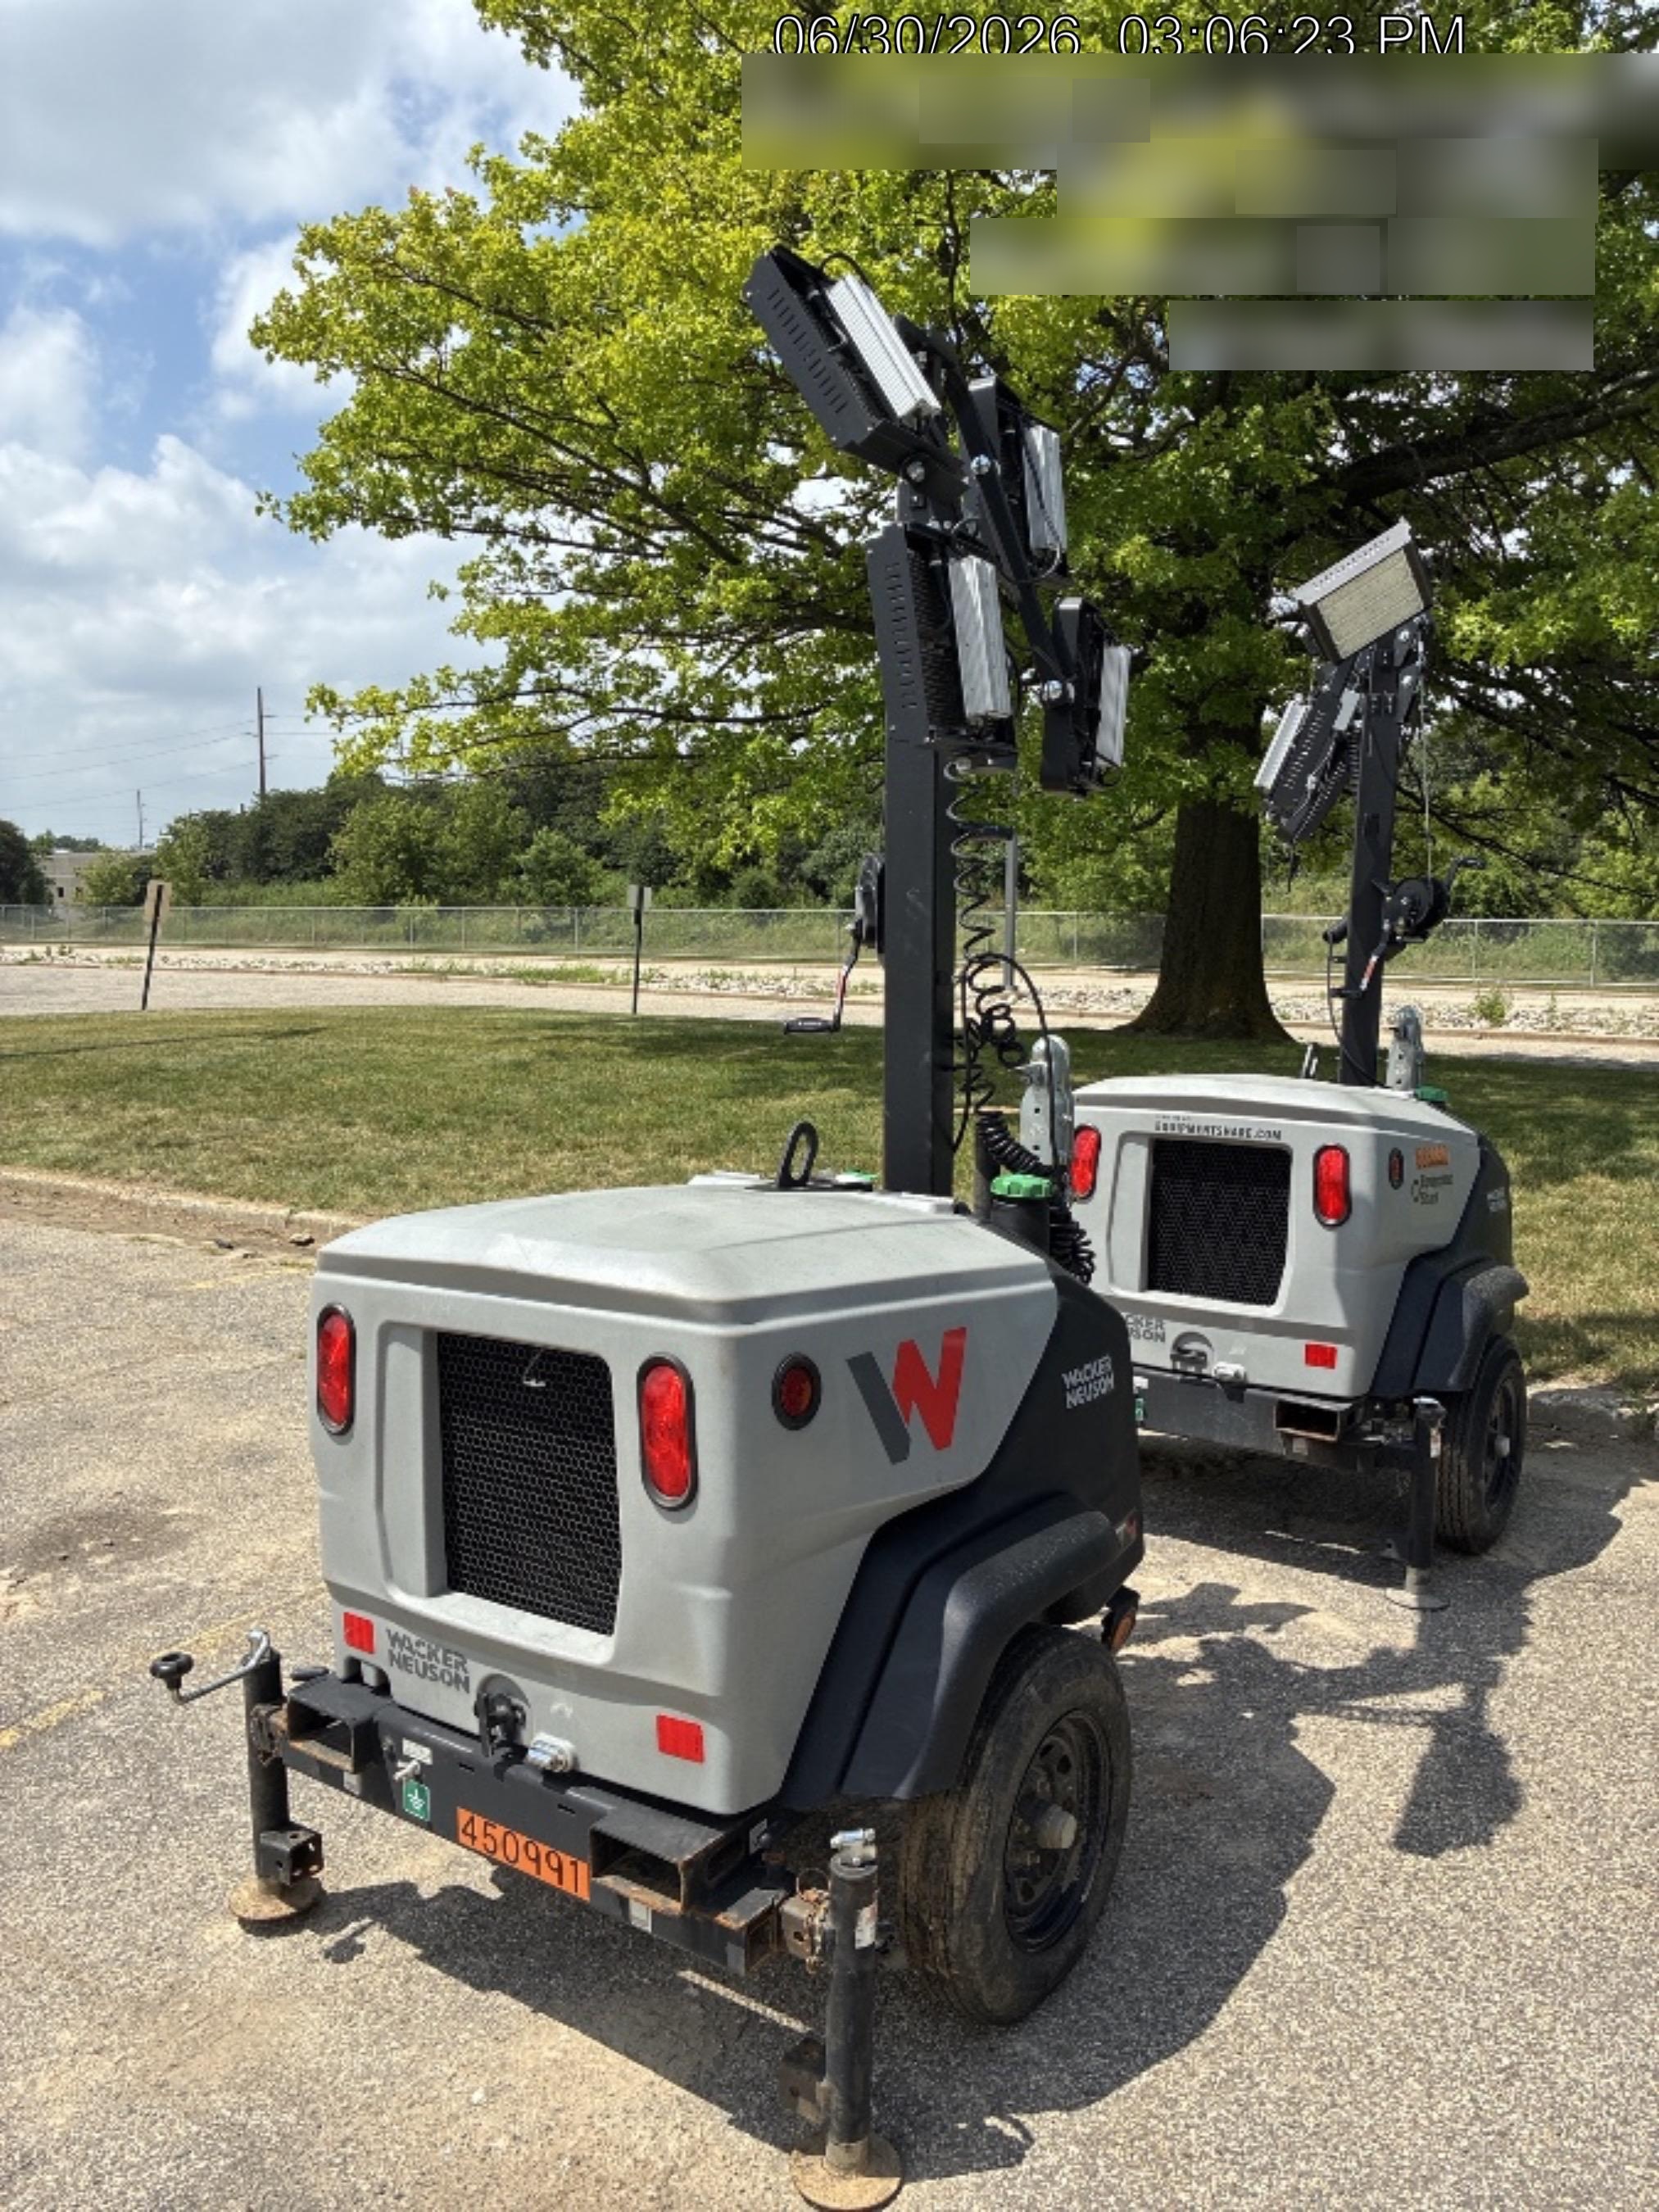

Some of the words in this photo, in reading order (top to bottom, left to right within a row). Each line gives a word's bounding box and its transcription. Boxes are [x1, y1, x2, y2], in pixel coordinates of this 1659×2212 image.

[1126, 1313, 1165, 1329] CKER
[1062, 1355, 1113, 1389] WACKER
[1066, 1372, 1114, 1409] NEUSON
[386, 1628, 469, 1675] WACKER
[388, 1648, 469, 1694] NEUSON
[461, 1815, 578, 1892] 450991
